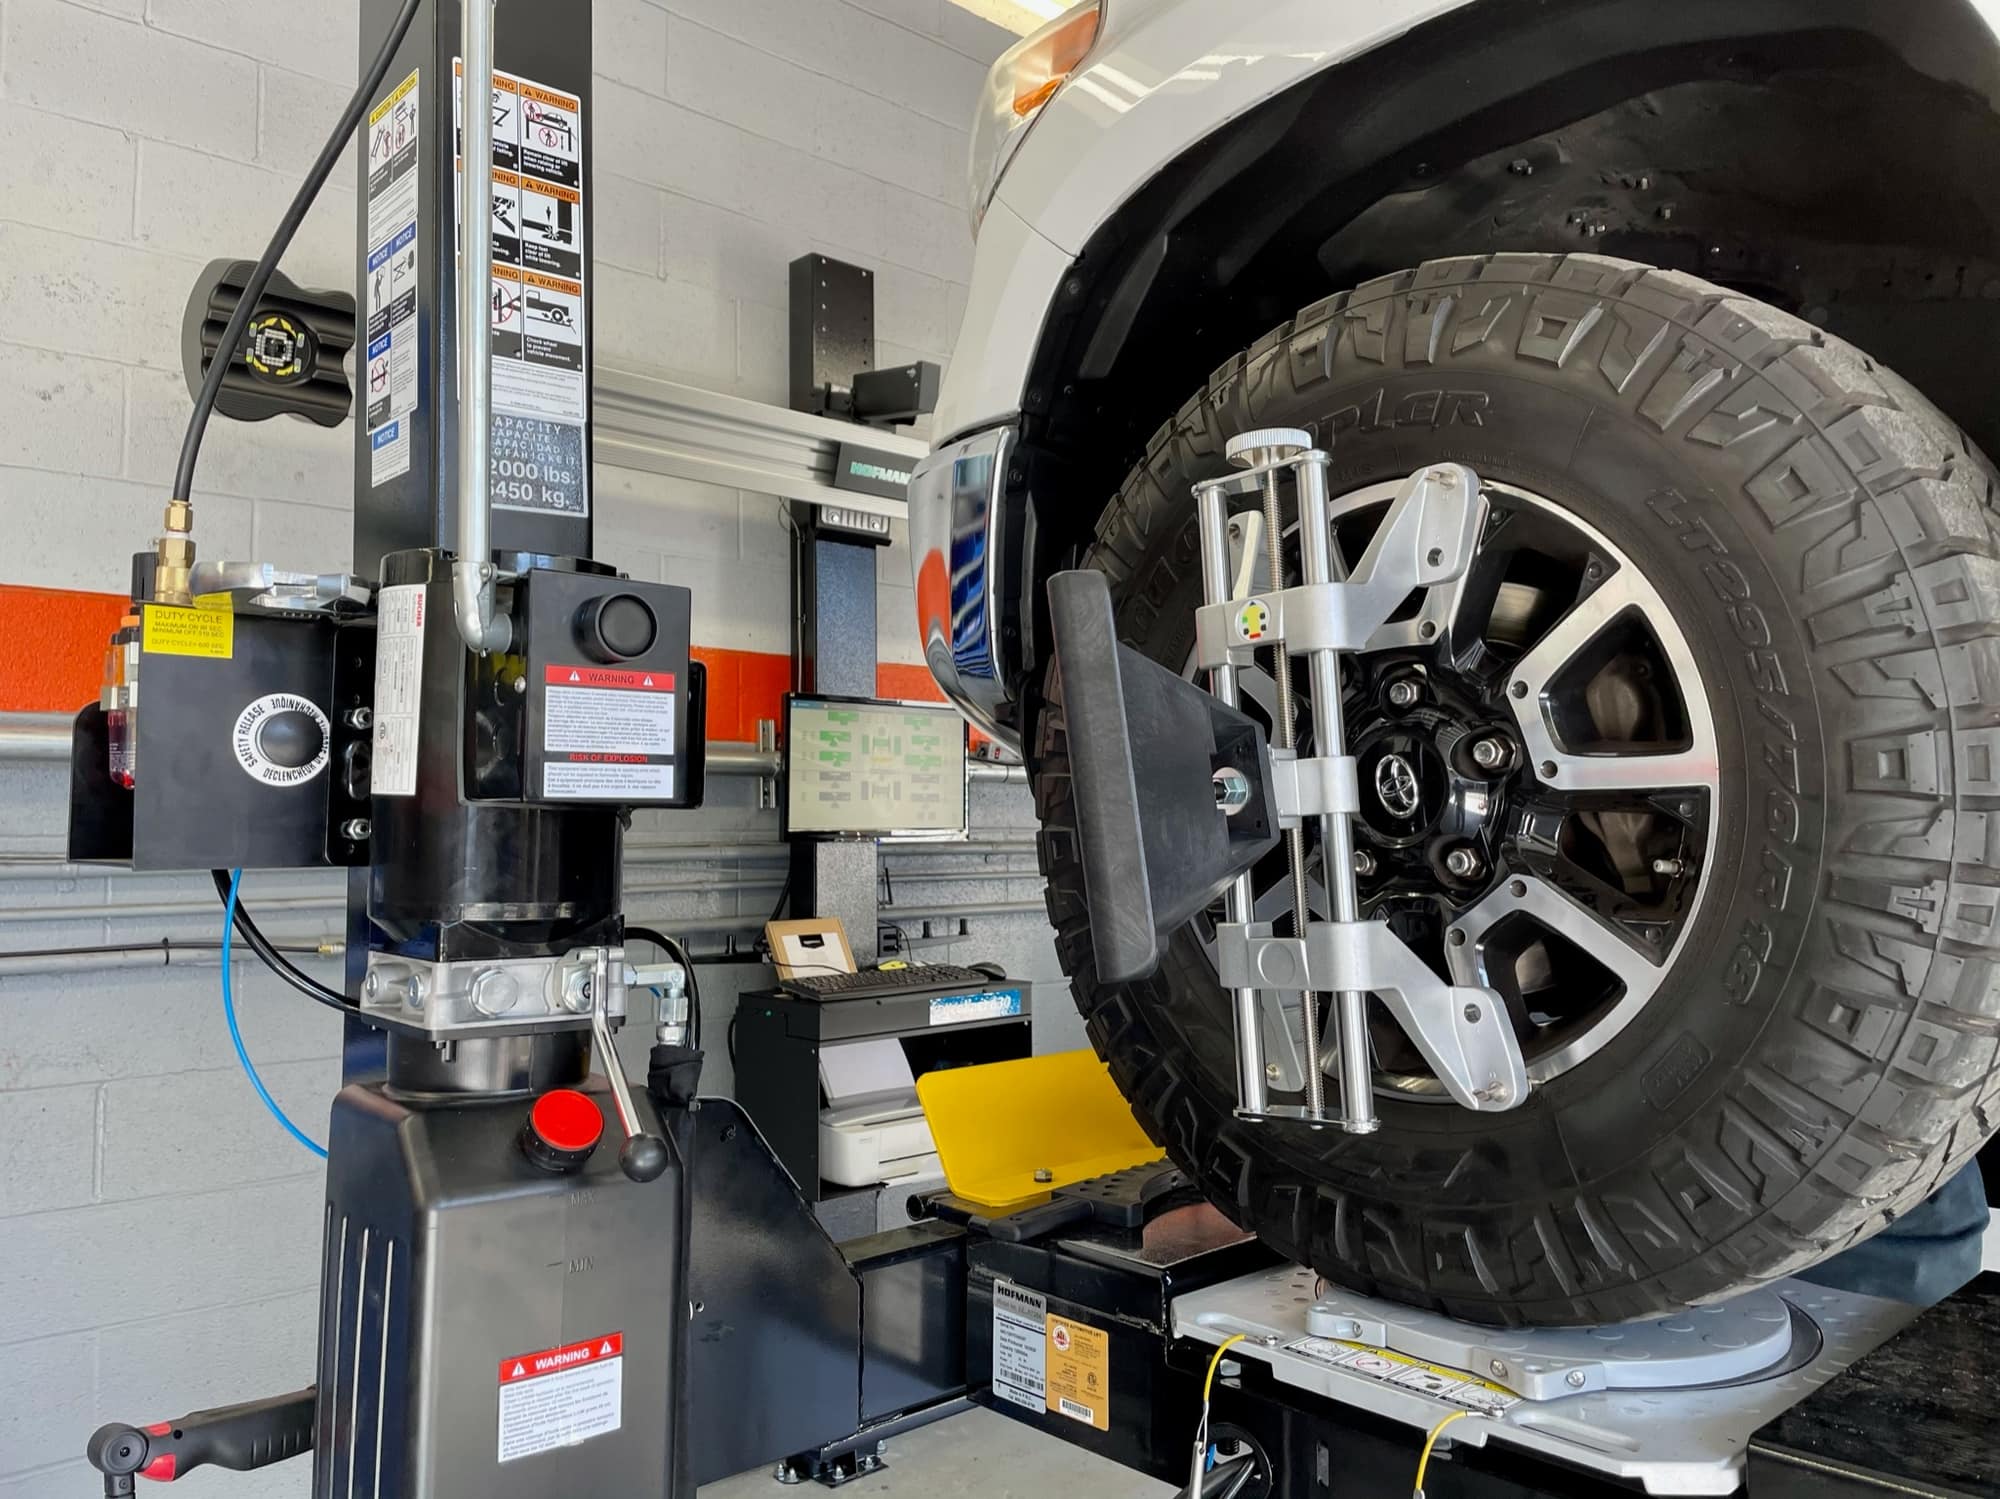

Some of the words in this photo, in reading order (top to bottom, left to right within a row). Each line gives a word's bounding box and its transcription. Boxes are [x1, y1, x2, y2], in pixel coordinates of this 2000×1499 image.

[535, 93, 576, 110] WARNING
[535, 183, 577, 201] WARNING
[538, 277, 579, 294] WARNING
[372, 337, 388, 353] NOTICE
[495, 416, 561, 435] APACITY
[377, 427, 395, 443] NOTICE
[495, 438, 560, 454] APACIDAD
[491, 458, 538, 479] 2000
[543, 465, 576, 485] lbs.
[850, 461, 912, 485] HOFMAN
[491, 481, 533, 501] 450
[542, 486, 570, 508] kg.
[155, 610, 185, 620] DUTY
[187, 613, 222, 624] CYCLE
[588, 673, 634, 684] WARNING
[238, 704, 265, 736] RELEASE
[238, 737, 258, 768] SAFETY
[604, 753, 648, 763] EXPLOSION
[998, 1285, 1041, 1309] HOFMANN
[535, 1348, 590, 1370] WARNING
